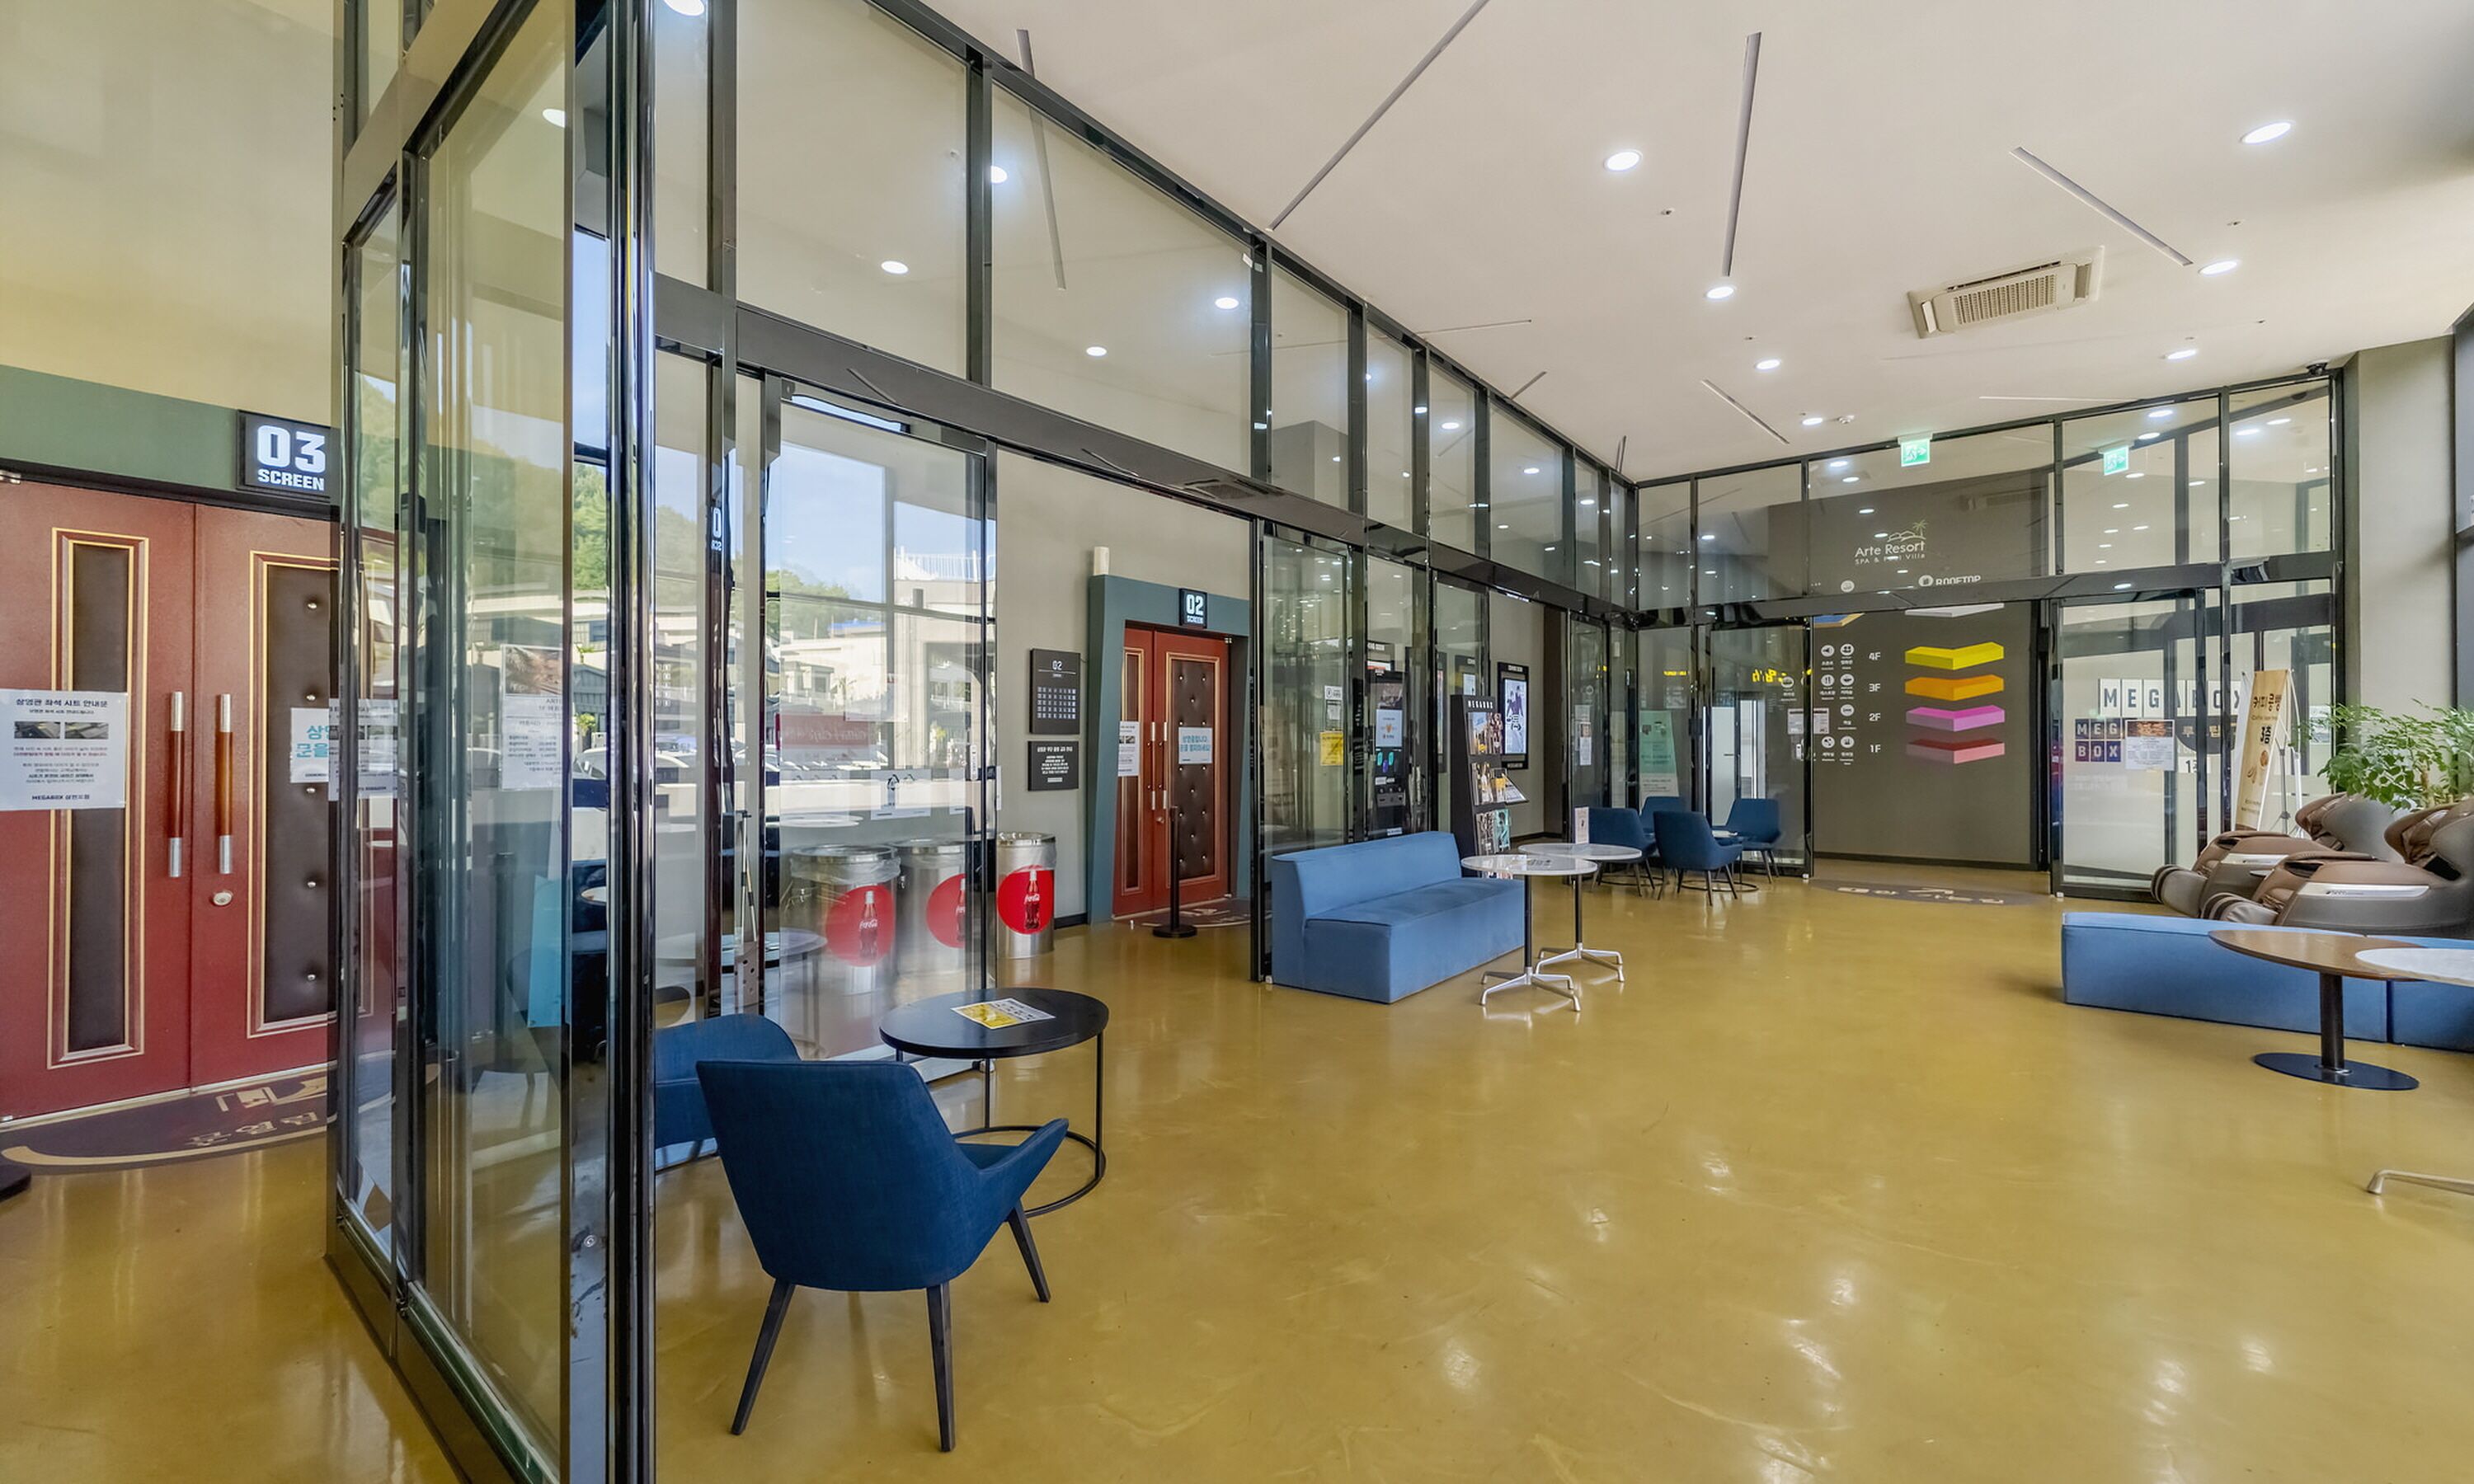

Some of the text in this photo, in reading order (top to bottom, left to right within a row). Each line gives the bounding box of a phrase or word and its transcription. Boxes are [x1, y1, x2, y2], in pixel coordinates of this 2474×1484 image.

[257, 425, 326, 473] 03
[257, 468, 325, 491] SCREEN
[1855, 541, 1925, 557] Arte Resort
[1186, 594, 1204, 616] 02
[1868, 651, 1881, 660] 4F
[1052, 660, 1063, 670] 02
[1869, 683, 1881, 692] 3F
[1869, 713, 1881, 721] 2F
[2077, 723, 2117, 735] MEG
[1870, 744, 1881, 753] 1F
[2078, 745, 2118, 758] BOX
